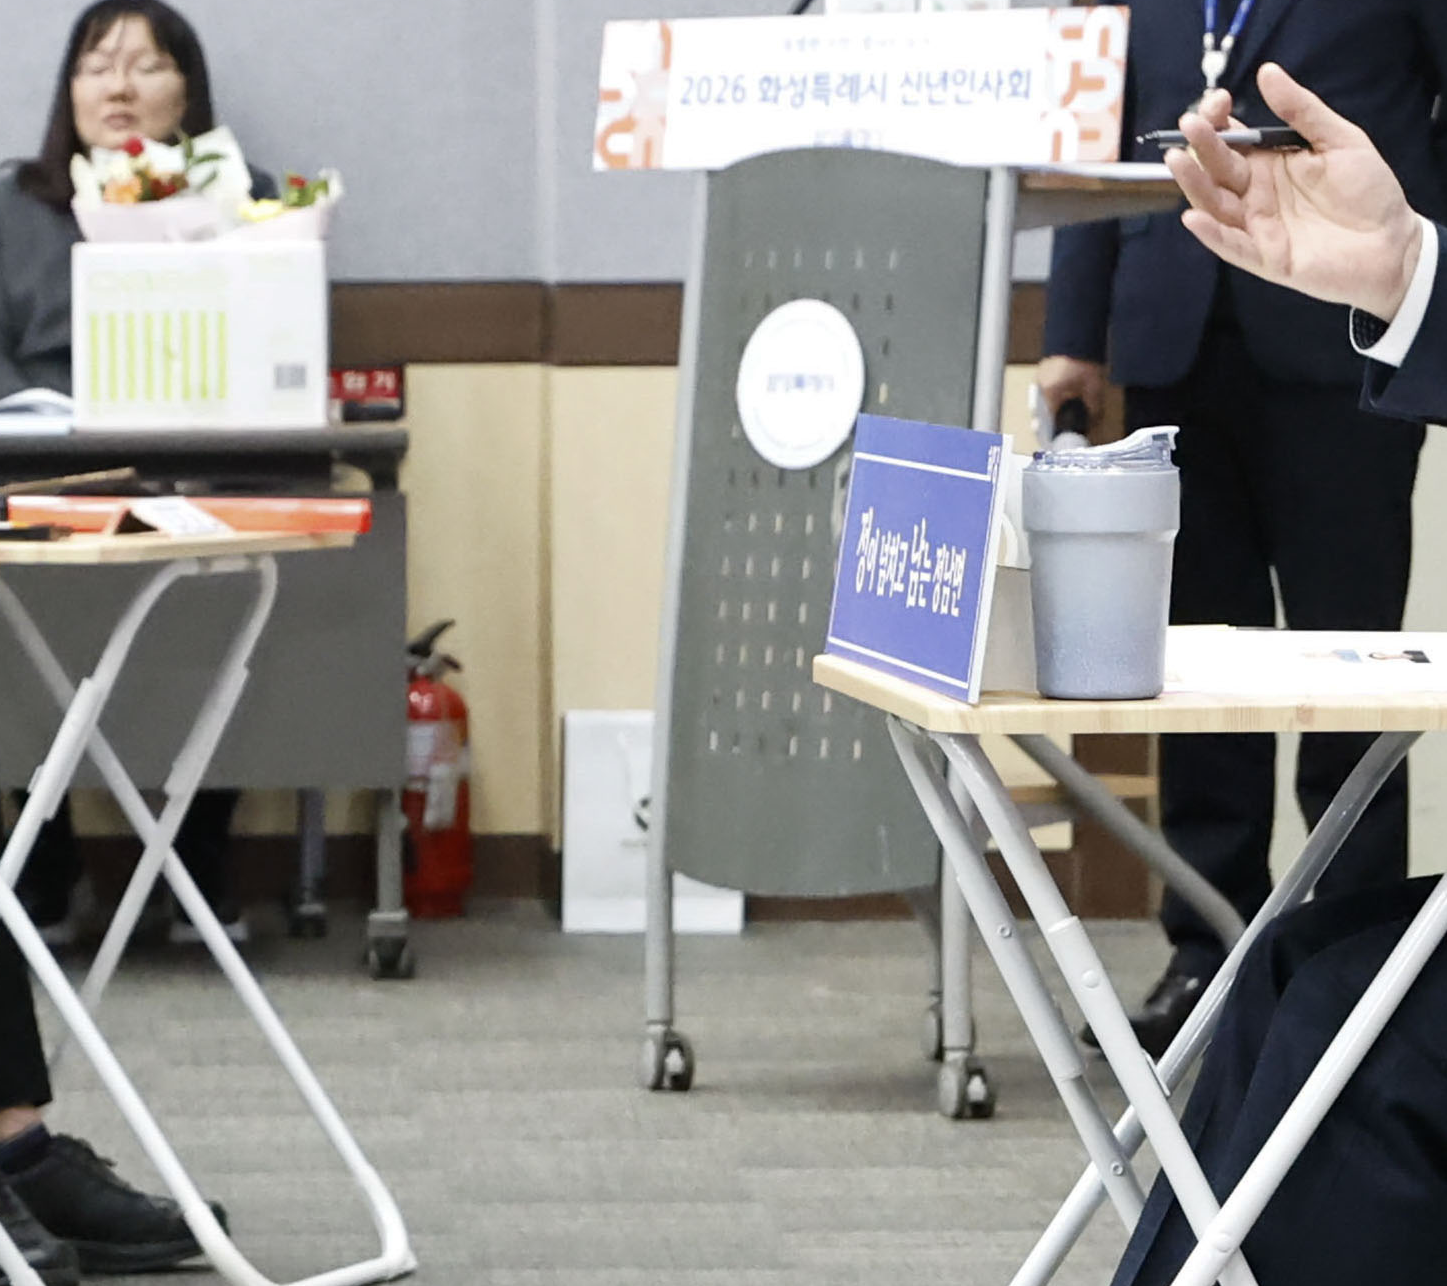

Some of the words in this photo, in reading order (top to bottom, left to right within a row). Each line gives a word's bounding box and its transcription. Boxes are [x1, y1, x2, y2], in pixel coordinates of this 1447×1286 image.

[679, 73, 747, 106] 2026
[757, 70, 888, 108] 화성특례시
[899, 67, 1032, 107] 신년인사회
[855, 506, 881, 593] 정이
[931, 543, 967, 617] 정남면
